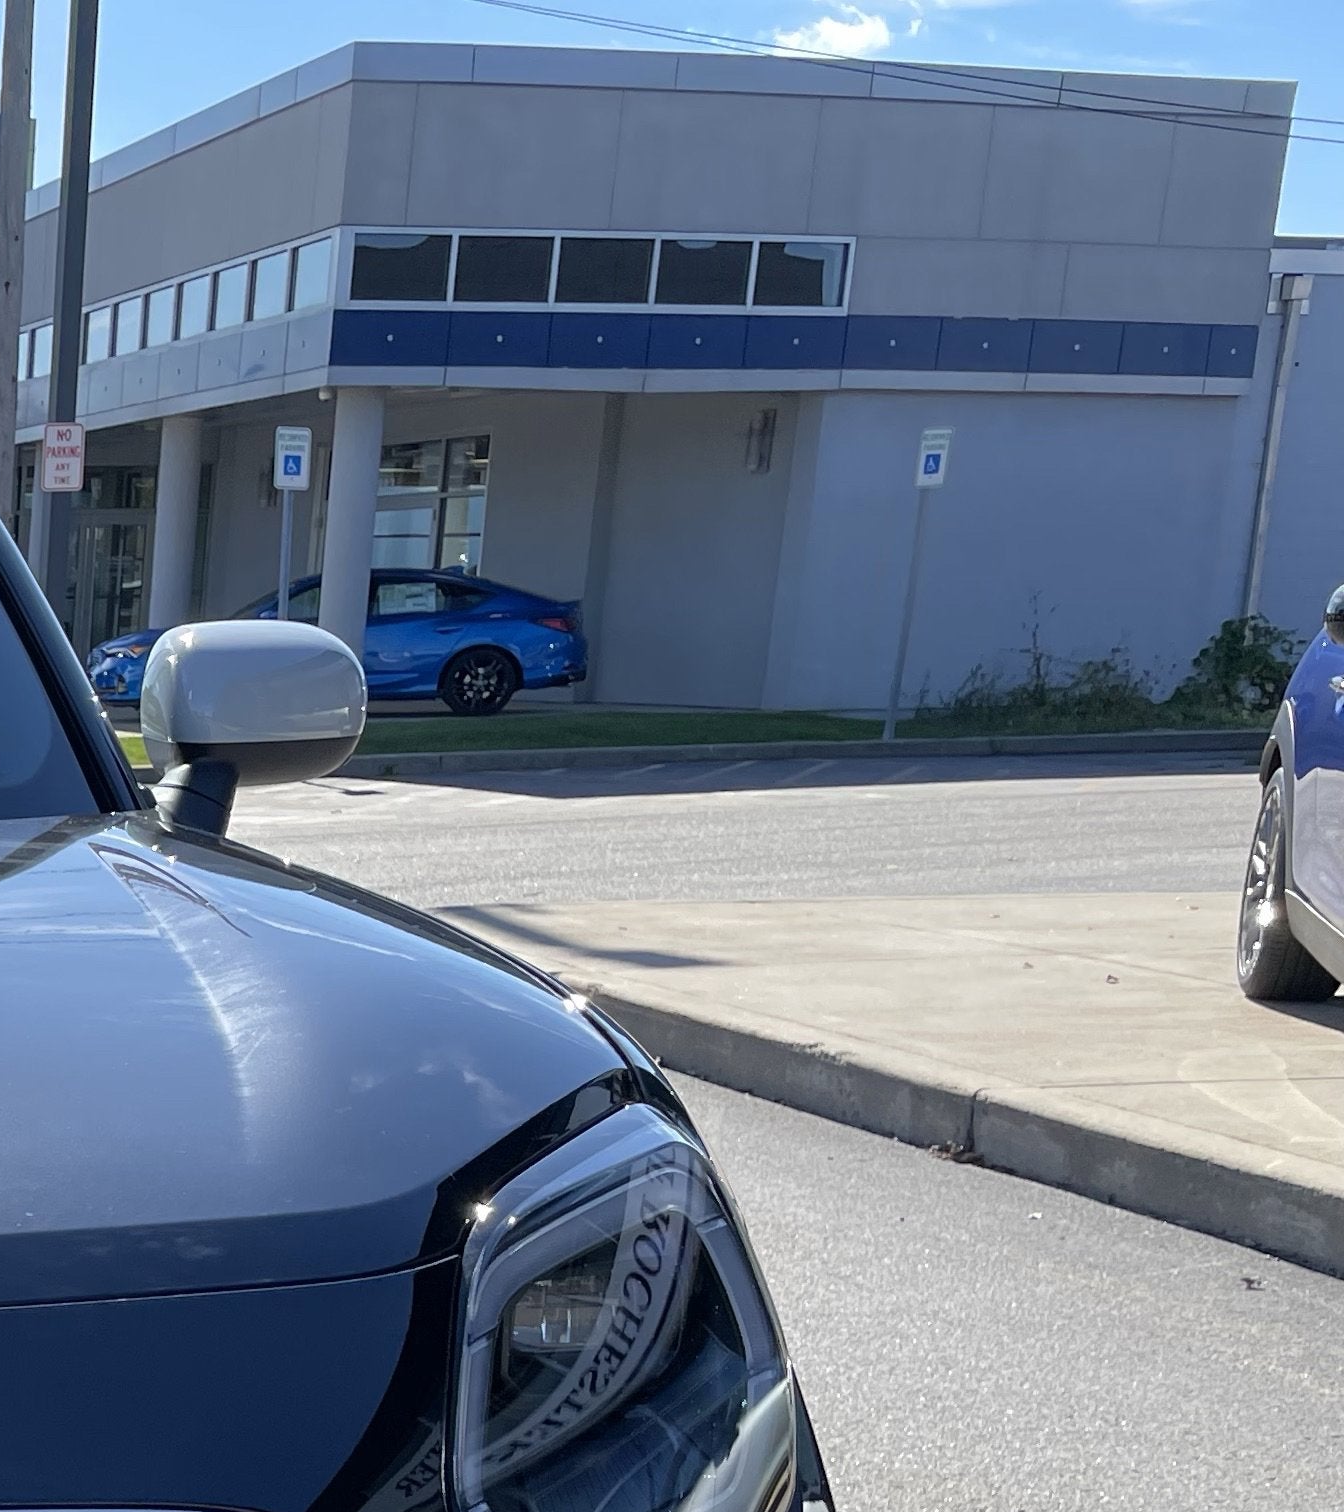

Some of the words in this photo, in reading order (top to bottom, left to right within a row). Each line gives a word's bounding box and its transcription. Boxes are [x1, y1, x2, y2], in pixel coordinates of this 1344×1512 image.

[57, 429, 72, 441] NO
[46, 445, 81, 458] PARKING
[55, 463, 70, 471] ANY
[54, 476, 71, 485] TIME
